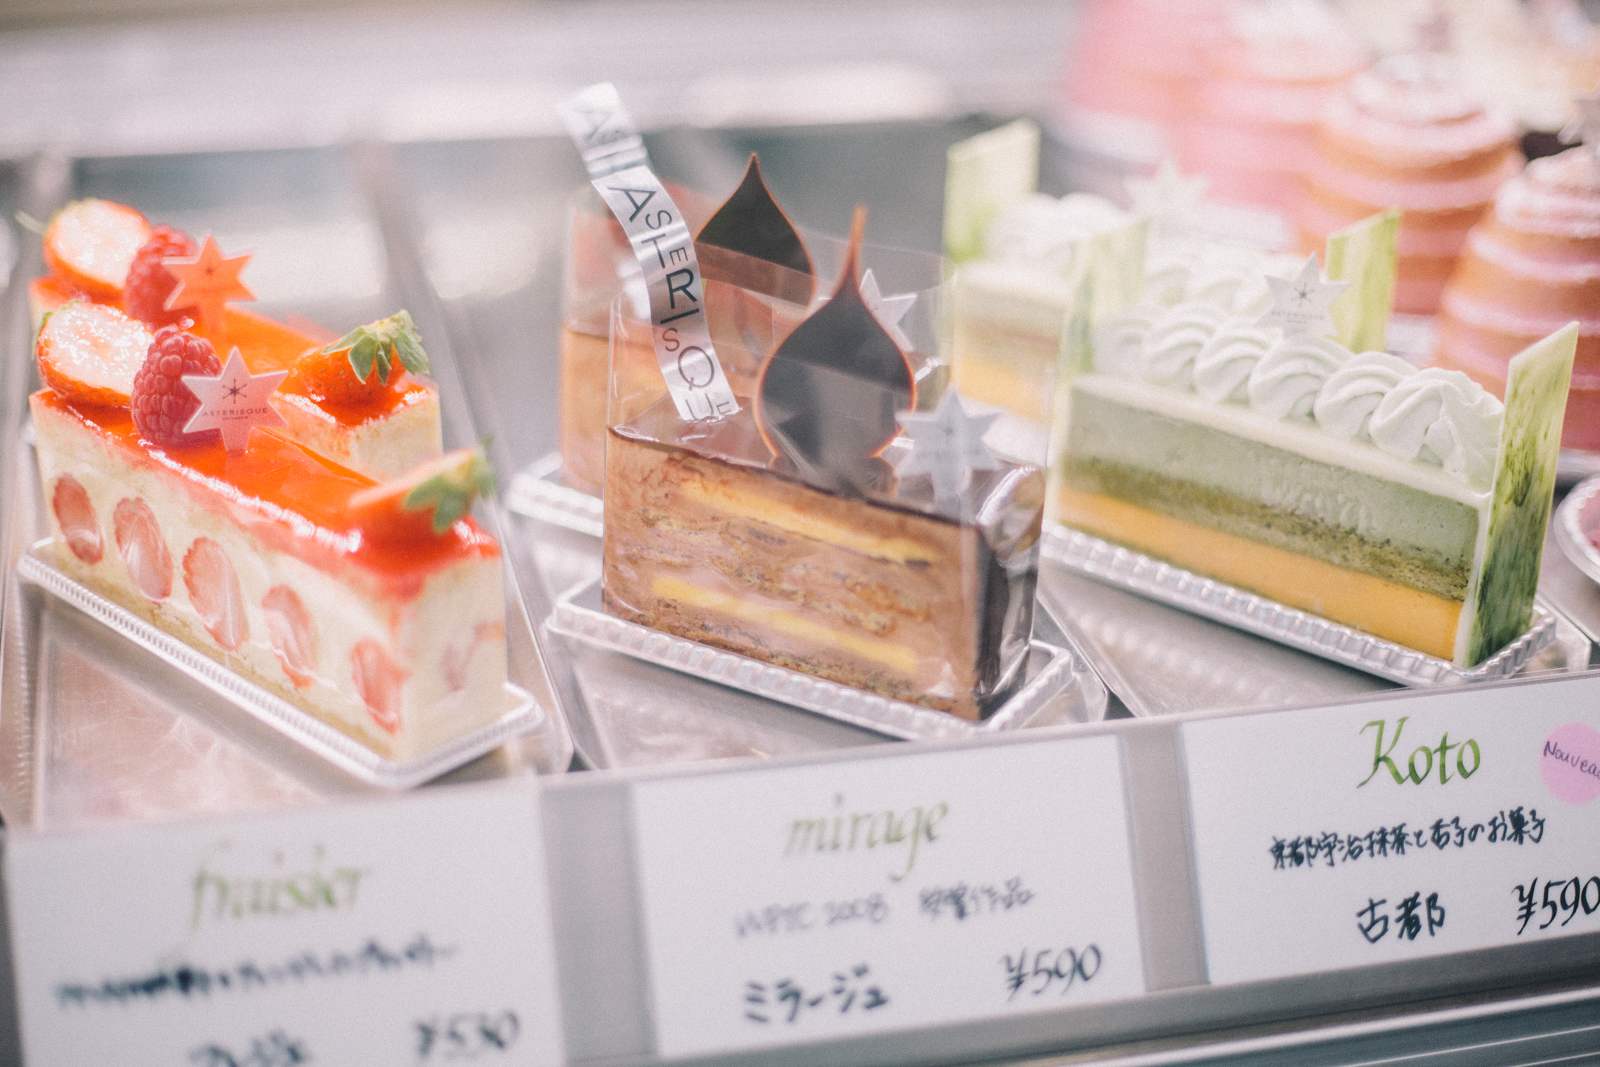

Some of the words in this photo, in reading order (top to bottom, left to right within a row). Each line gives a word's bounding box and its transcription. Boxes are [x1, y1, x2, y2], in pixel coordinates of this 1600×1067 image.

[607, 186, 733, 420] ASTERISQUE
[202, 407, 268, 417] ASTERISQUE
[1356, 716, 1481, 789] Koto
[1543, 741, 1600, 779] Nouvea
[782, 794, 949, 882] mirage
[1356, 891, 1445, 943] 古都
[1511, 876, 1600, 936] ¥590
[744, 963, 890, 1023] ミラージュ
[1000, 943, 1102, 1002] ¥590
